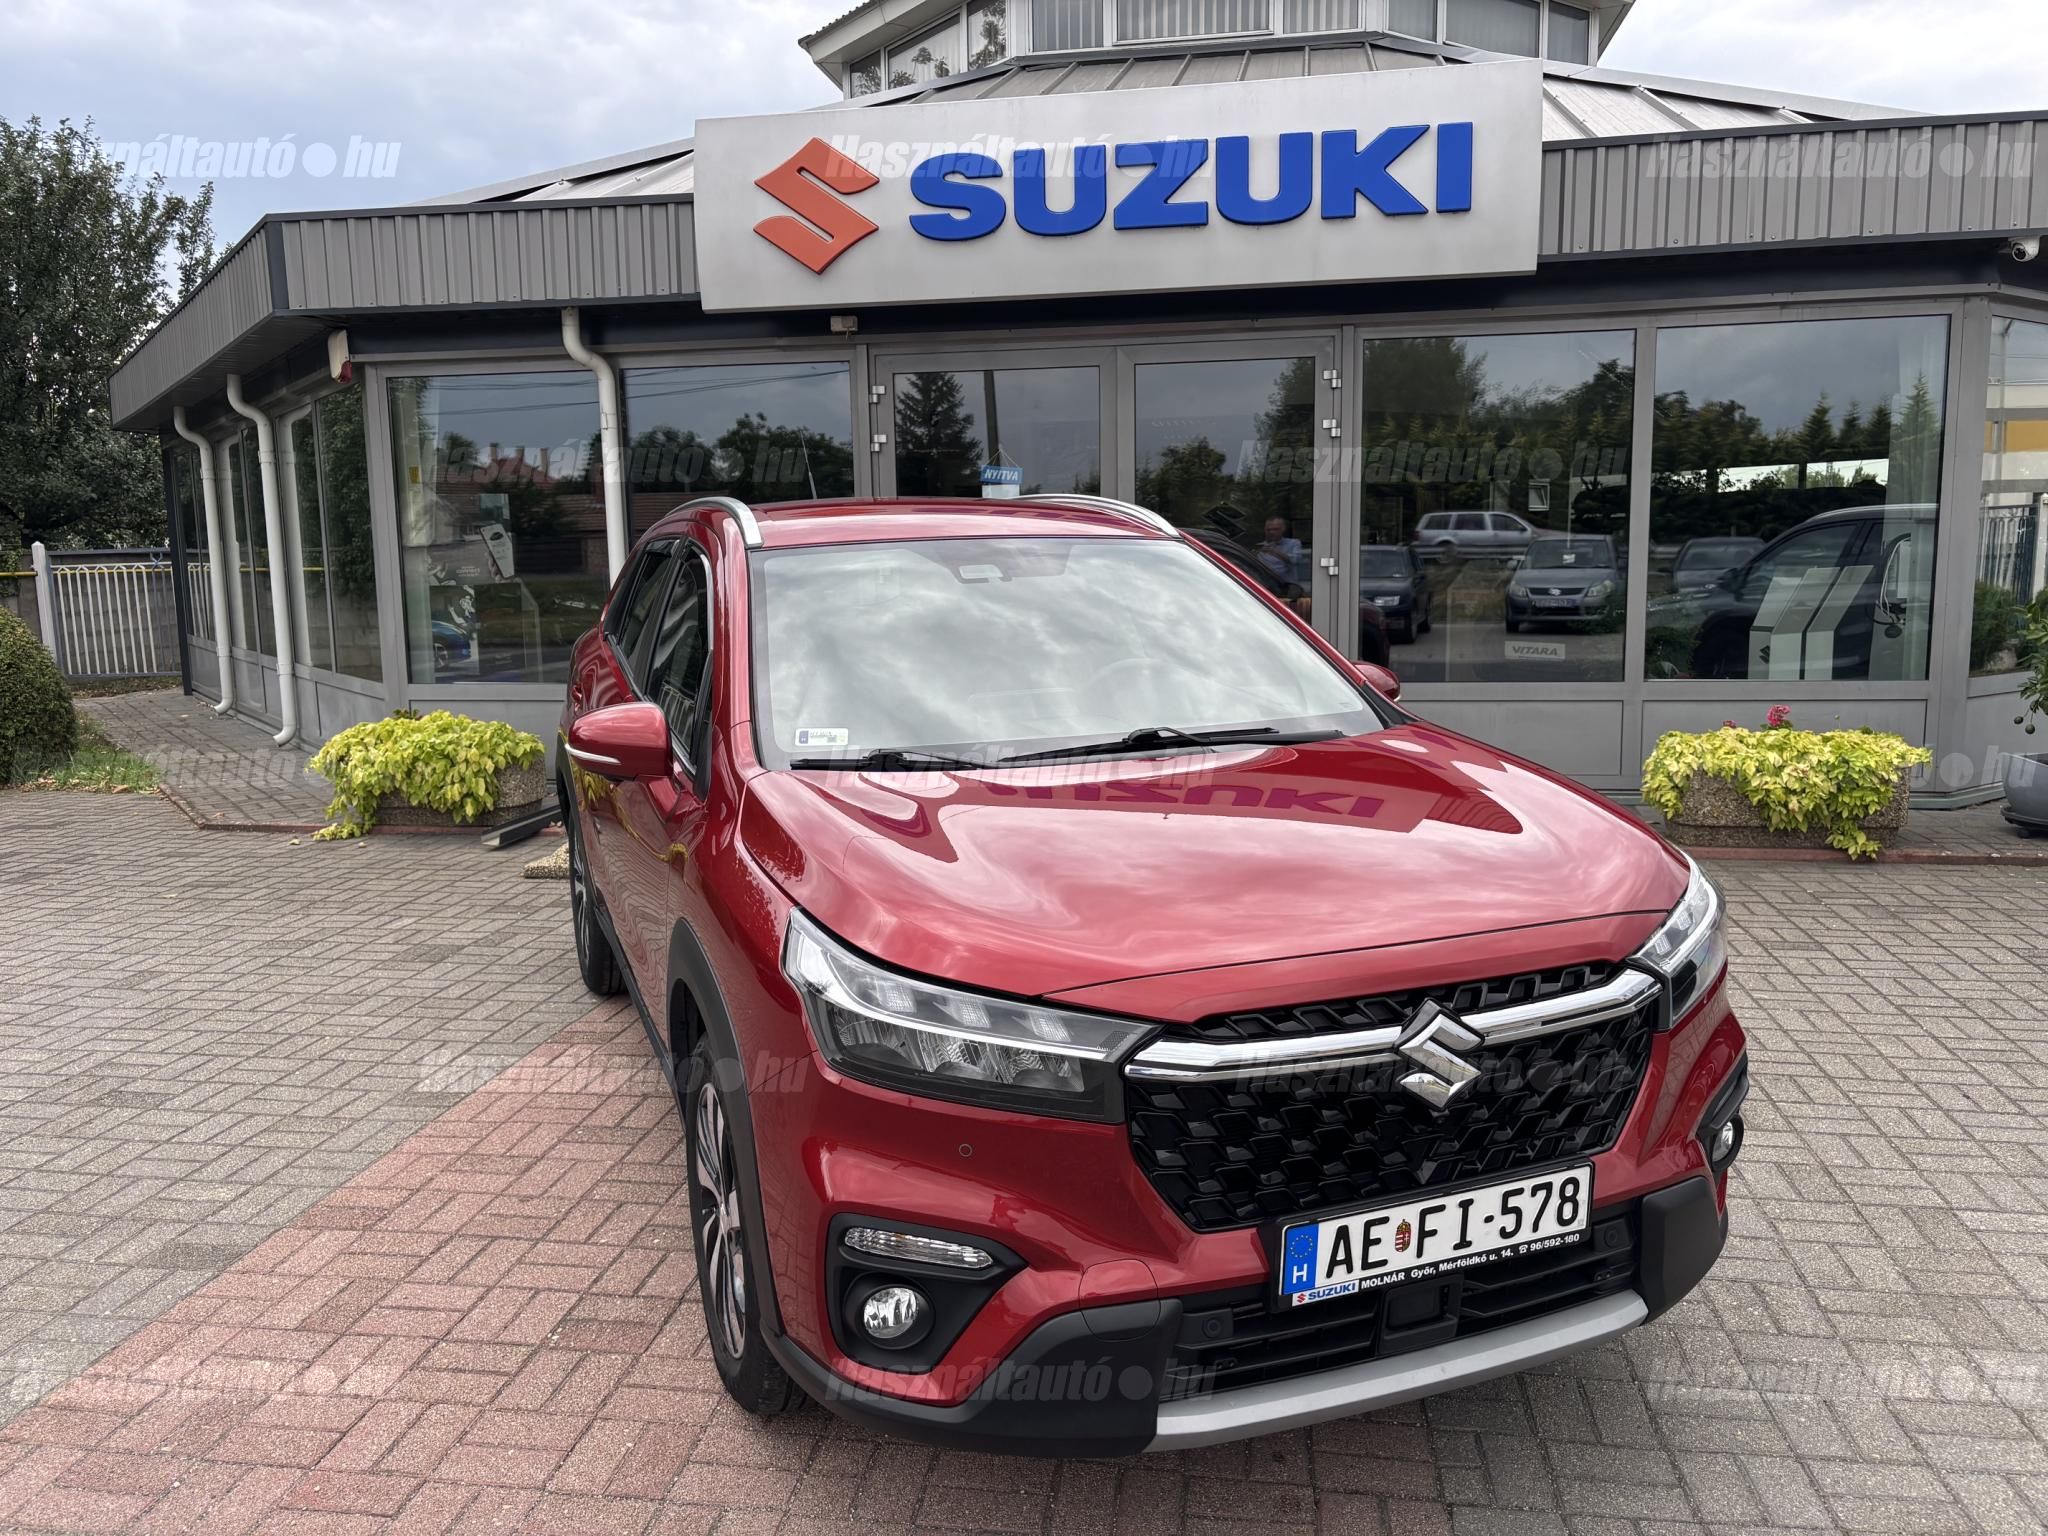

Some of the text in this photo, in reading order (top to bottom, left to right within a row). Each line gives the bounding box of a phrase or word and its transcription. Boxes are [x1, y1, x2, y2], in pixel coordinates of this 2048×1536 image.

[909, 121, 1474, 241] SUZUKI
[984, 468, 1019, 481] NYITVA
[1512, 646, 1558, 656] VITARA
[1292, 1263, 1308, 1284] H
[1308, 1282, 1356, 1300] SUZUKI
[1361, 1271, 1406, 1289] MOLNÁR
[1500, 1249, 1514, 1258] 14.
[1530, 1233, 1580, 1252] 96/592-180
